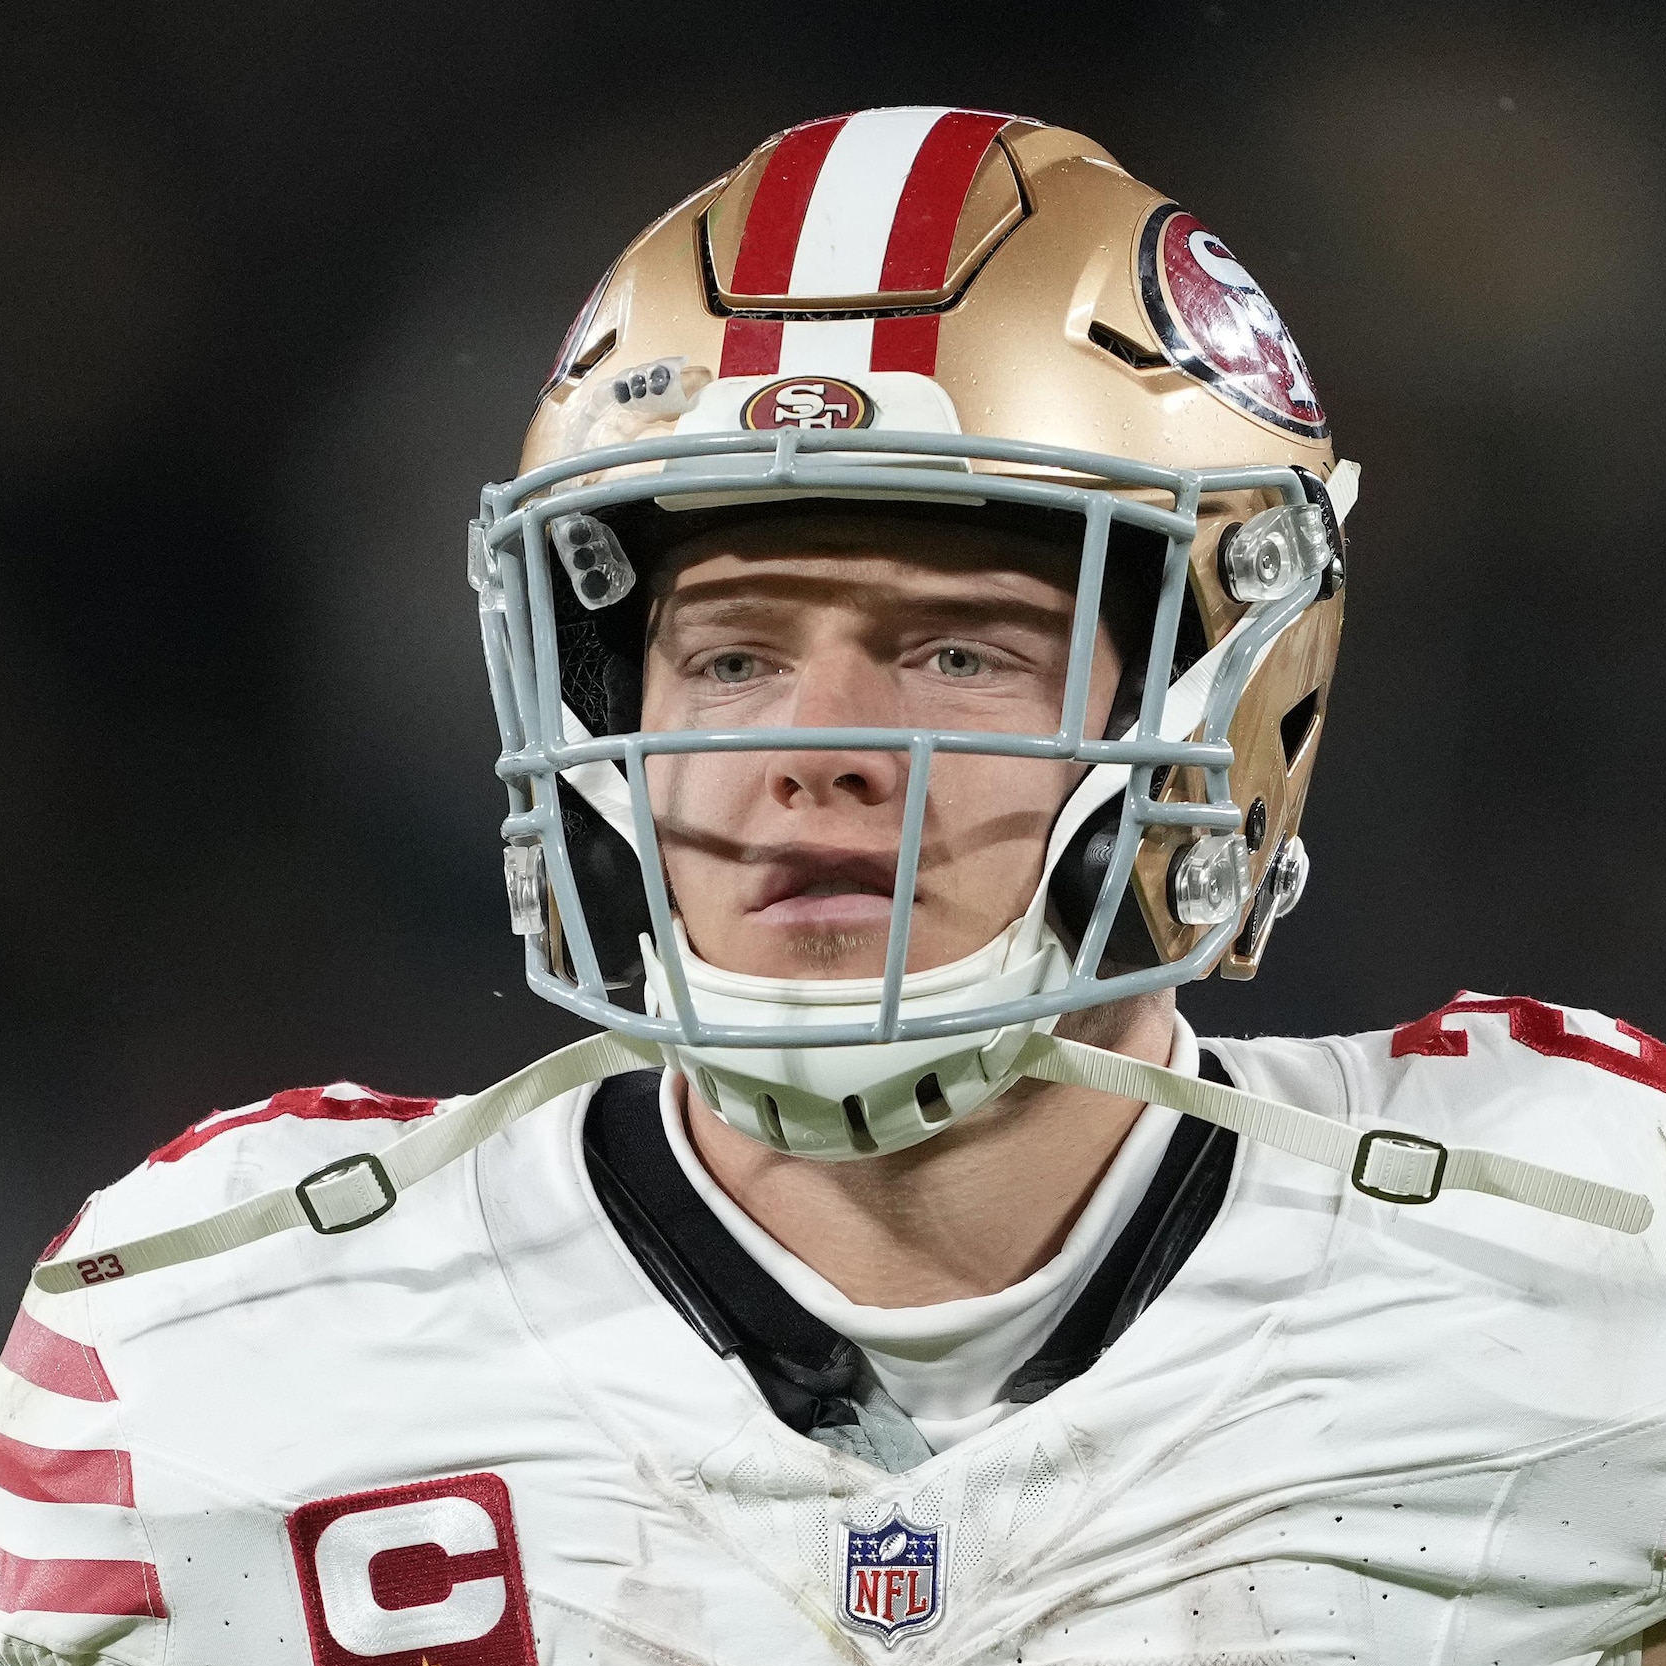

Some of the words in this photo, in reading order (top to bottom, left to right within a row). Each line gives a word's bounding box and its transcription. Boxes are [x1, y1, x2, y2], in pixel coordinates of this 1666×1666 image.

[77, 1254, 125, 1284] 23
[314, 1496, 507, 1657] C
[855, 1570, 927, 1622] NFL
